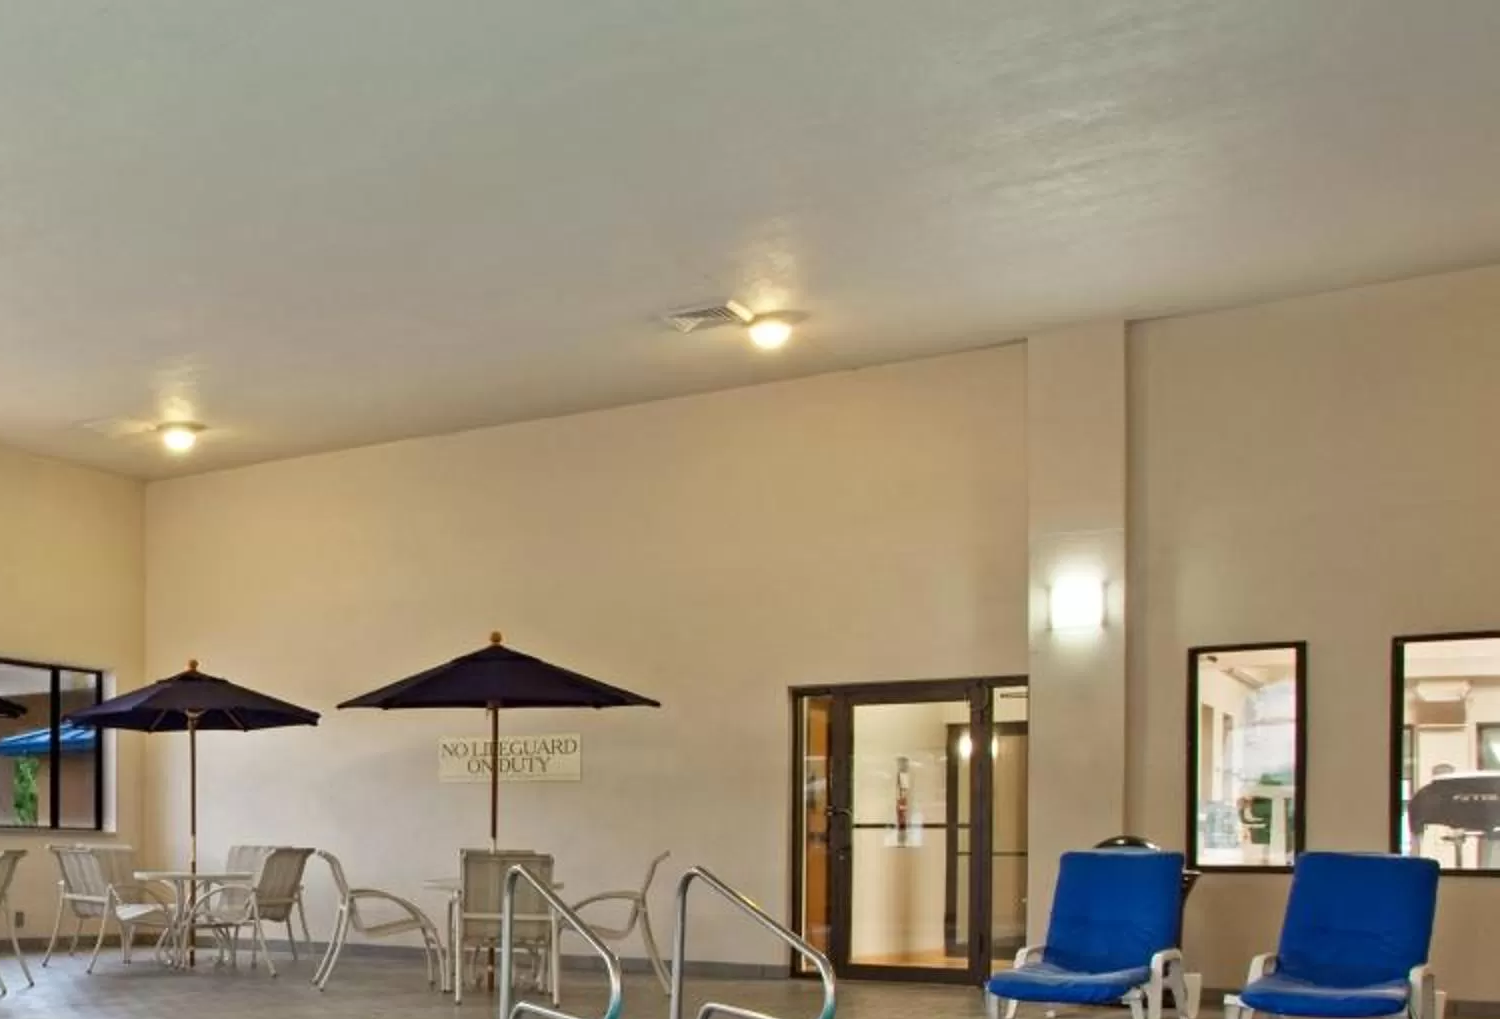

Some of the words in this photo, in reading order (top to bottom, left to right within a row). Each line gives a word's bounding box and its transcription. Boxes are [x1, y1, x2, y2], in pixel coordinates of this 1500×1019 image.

[442, 742, 469, 757] NO
[472, 739, 578, 757] LIEGUARD
[467, 758, 494, 773] ON
[499, 756, 551, 773] DUTY
